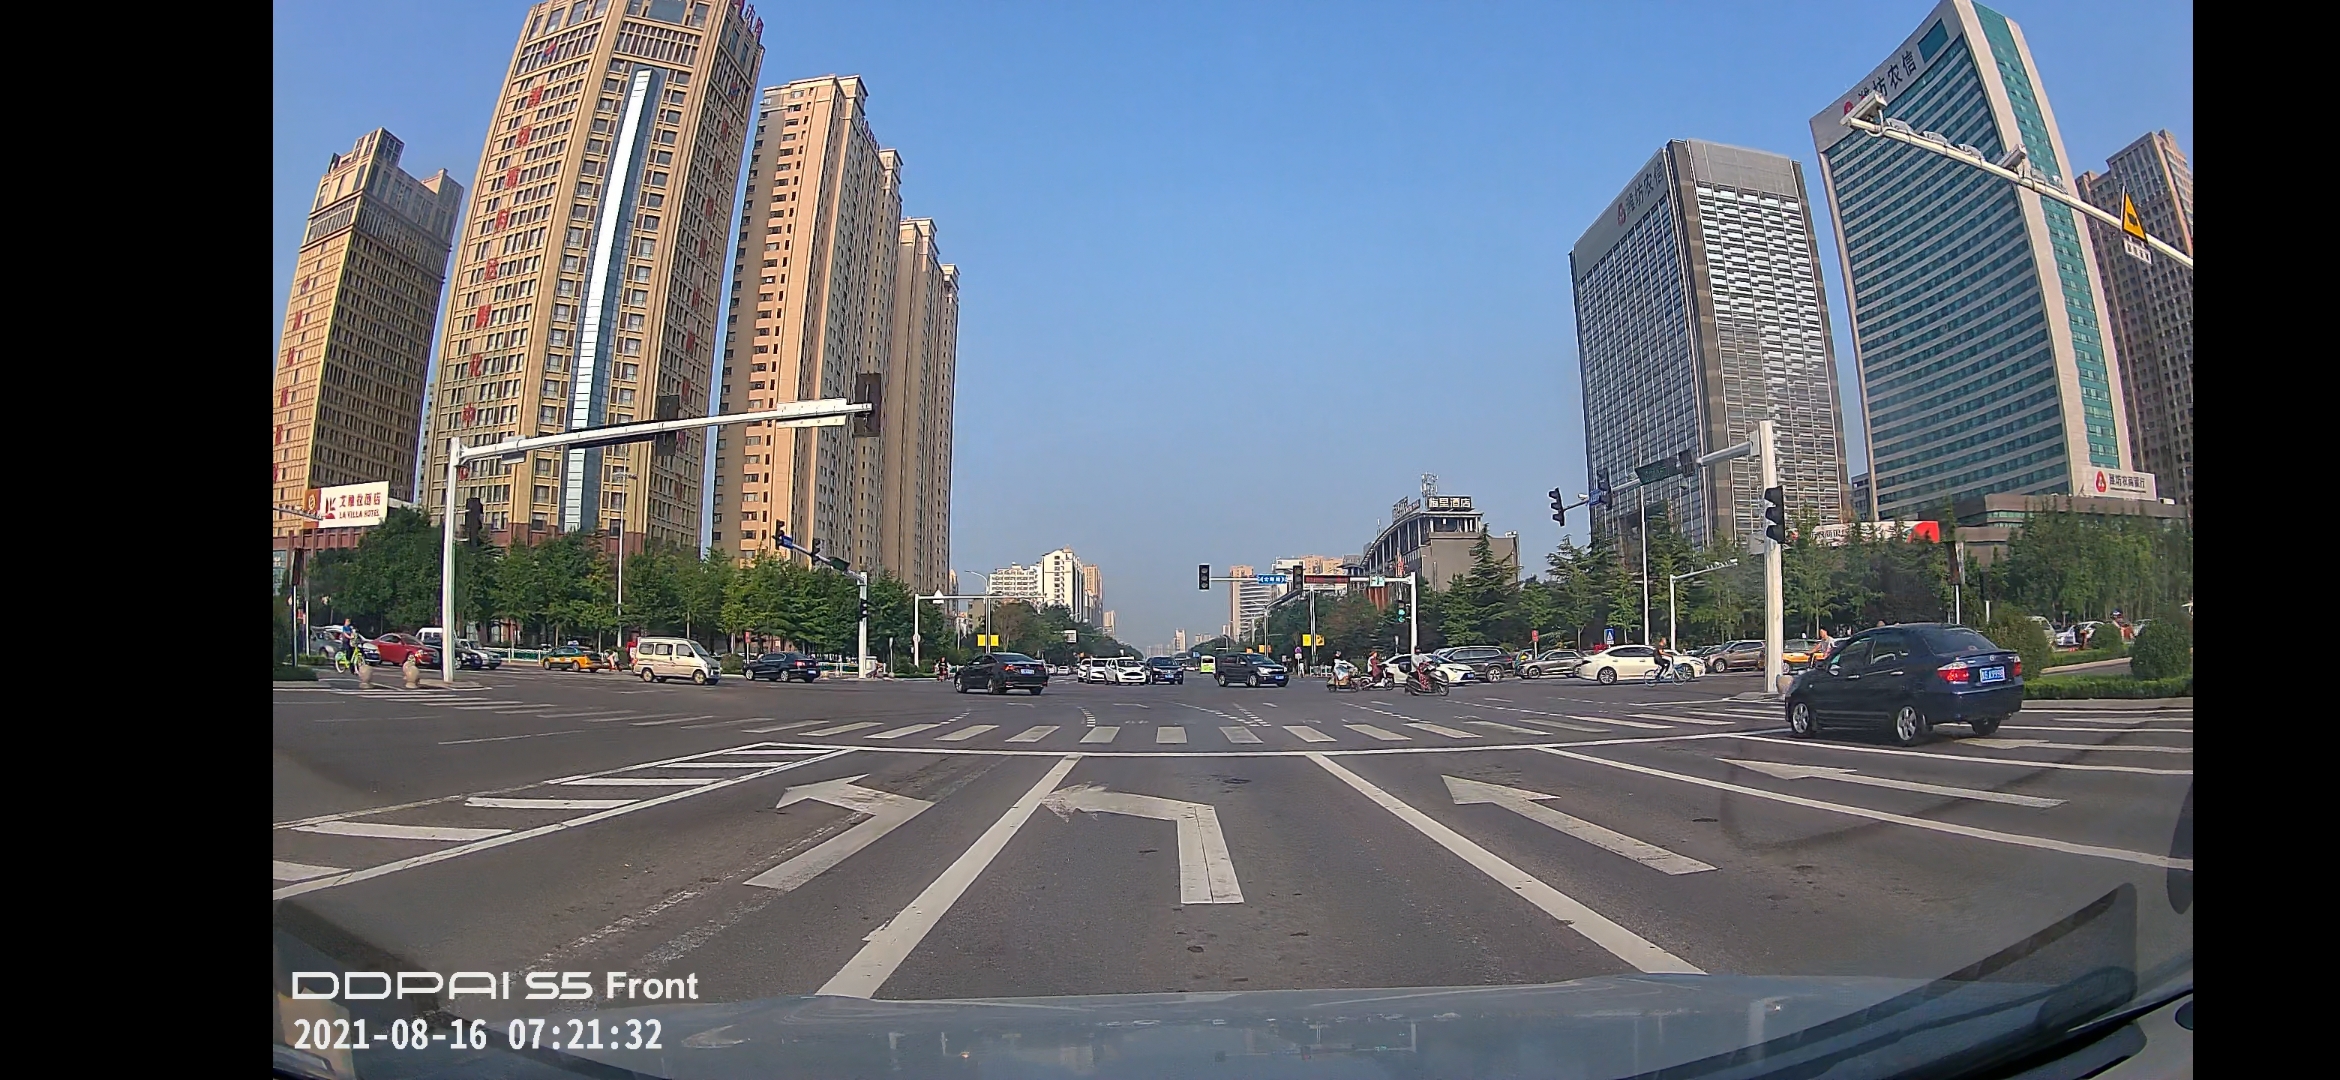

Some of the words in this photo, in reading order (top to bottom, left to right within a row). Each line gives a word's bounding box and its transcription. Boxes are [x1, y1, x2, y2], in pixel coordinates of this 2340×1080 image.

[339, 511, 347, 519] LA
[347, 510, 363, 519] VILLA
[363, 509, 380, 518] HOTEL
